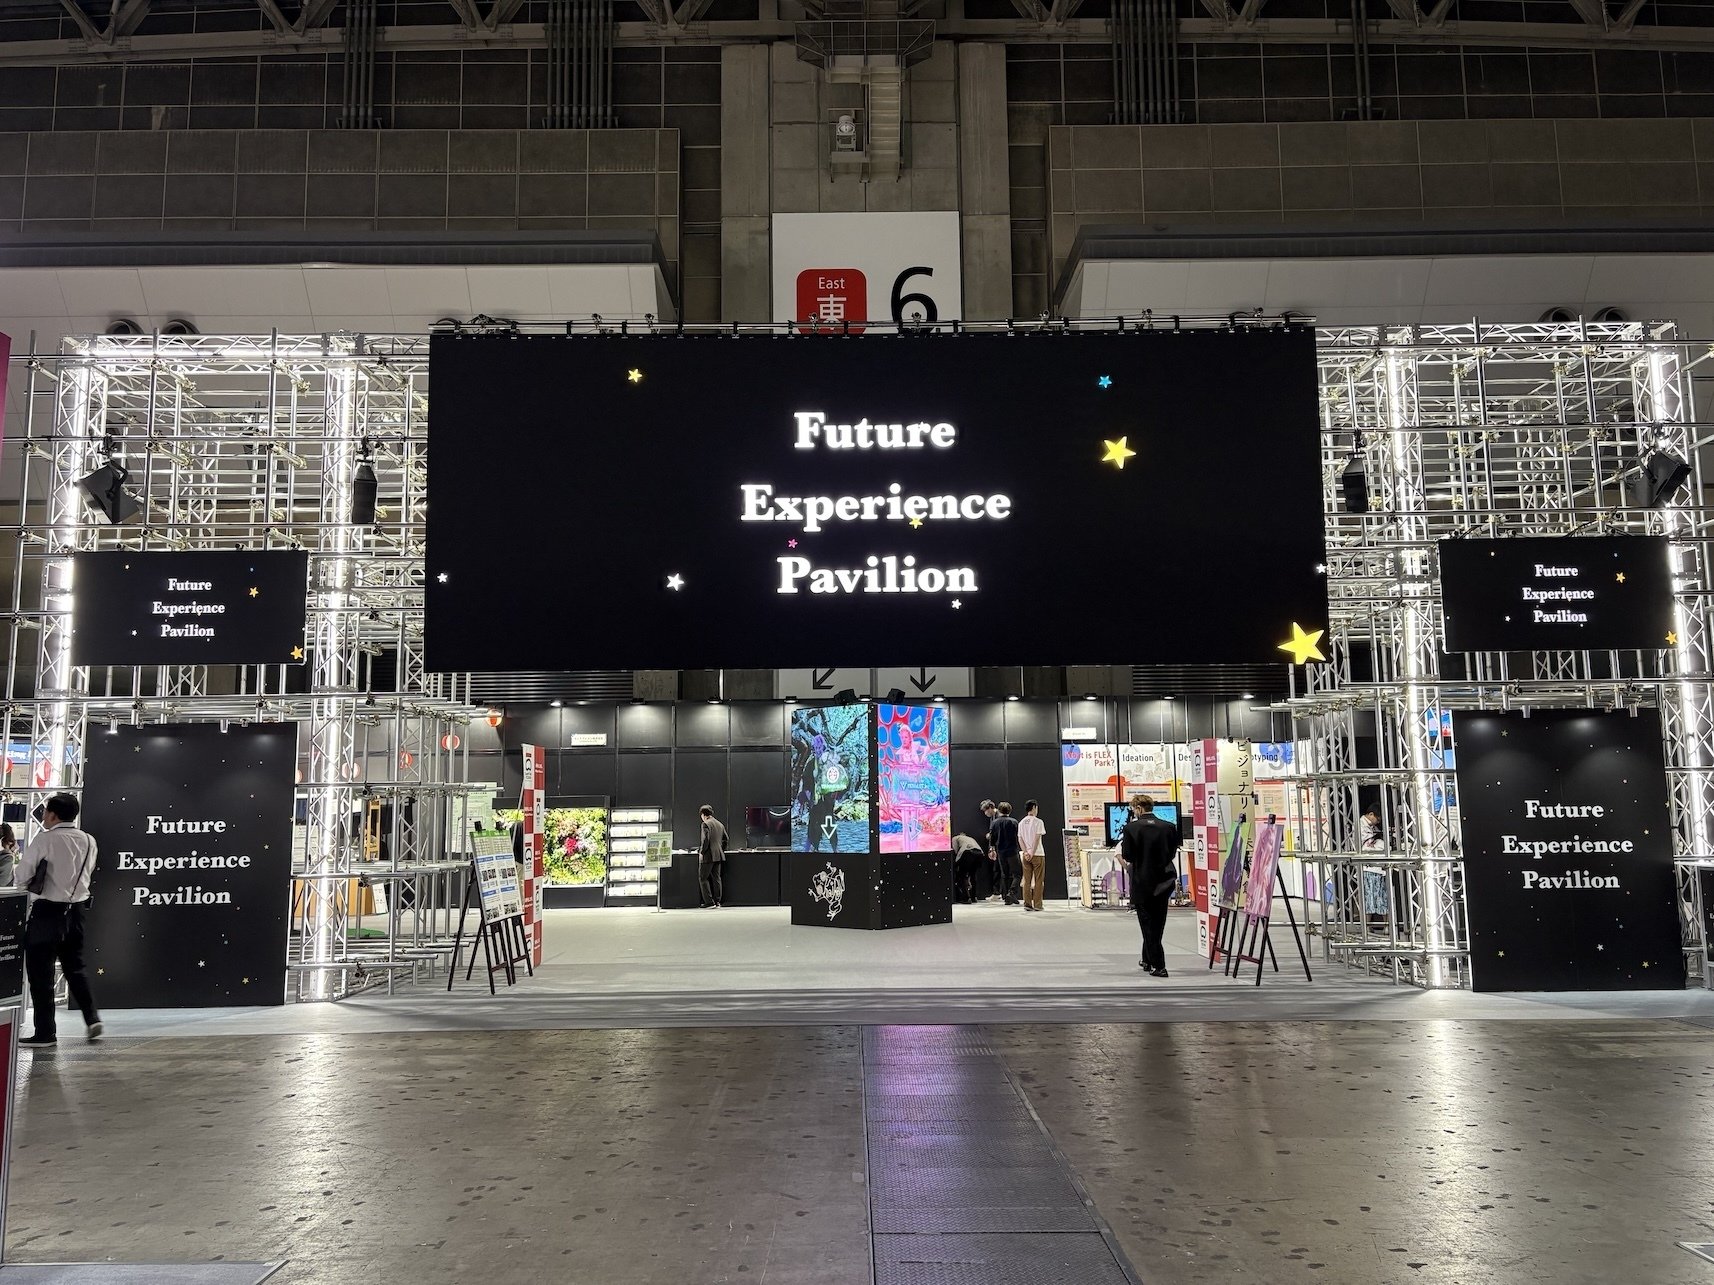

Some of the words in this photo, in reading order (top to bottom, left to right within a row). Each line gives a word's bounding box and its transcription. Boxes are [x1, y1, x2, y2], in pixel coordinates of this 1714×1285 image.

[818, 277, 845, 290] East
[890, 266, 938, 333] 6
[817, 294, 847, 331] 東
[794, 412, 956, 450] Future
[740, 483, 1012, 533] Experience
[776, 556, 979, 594] Pavilion
[1534, 564, 1579, 577] Future
[167, 578, 213, 591] Future
[1522, 587, 1595, 603] Experience
[152, 601, 226, 617] Experience
[1533, 610, 1588, 623] Pavilion
[160, 624, 215, 637] Pavilion
[1085, 751, 1092, 759] is
[1094, 751, 1112, 759] FLEX
[1094, 759, 1115, 767] Park?
[1122, 753, 1154, 762] Ideation
[1525, 799, 1605, 818] Future
[146, 816, 227, 833] Future
[1501, 835, 1634, 859] Experience
[117, 850, 251, 875] Experience
[1521, 869, 1621, 889] Pavilion
[133, 885, 232, 906] Pavilion
